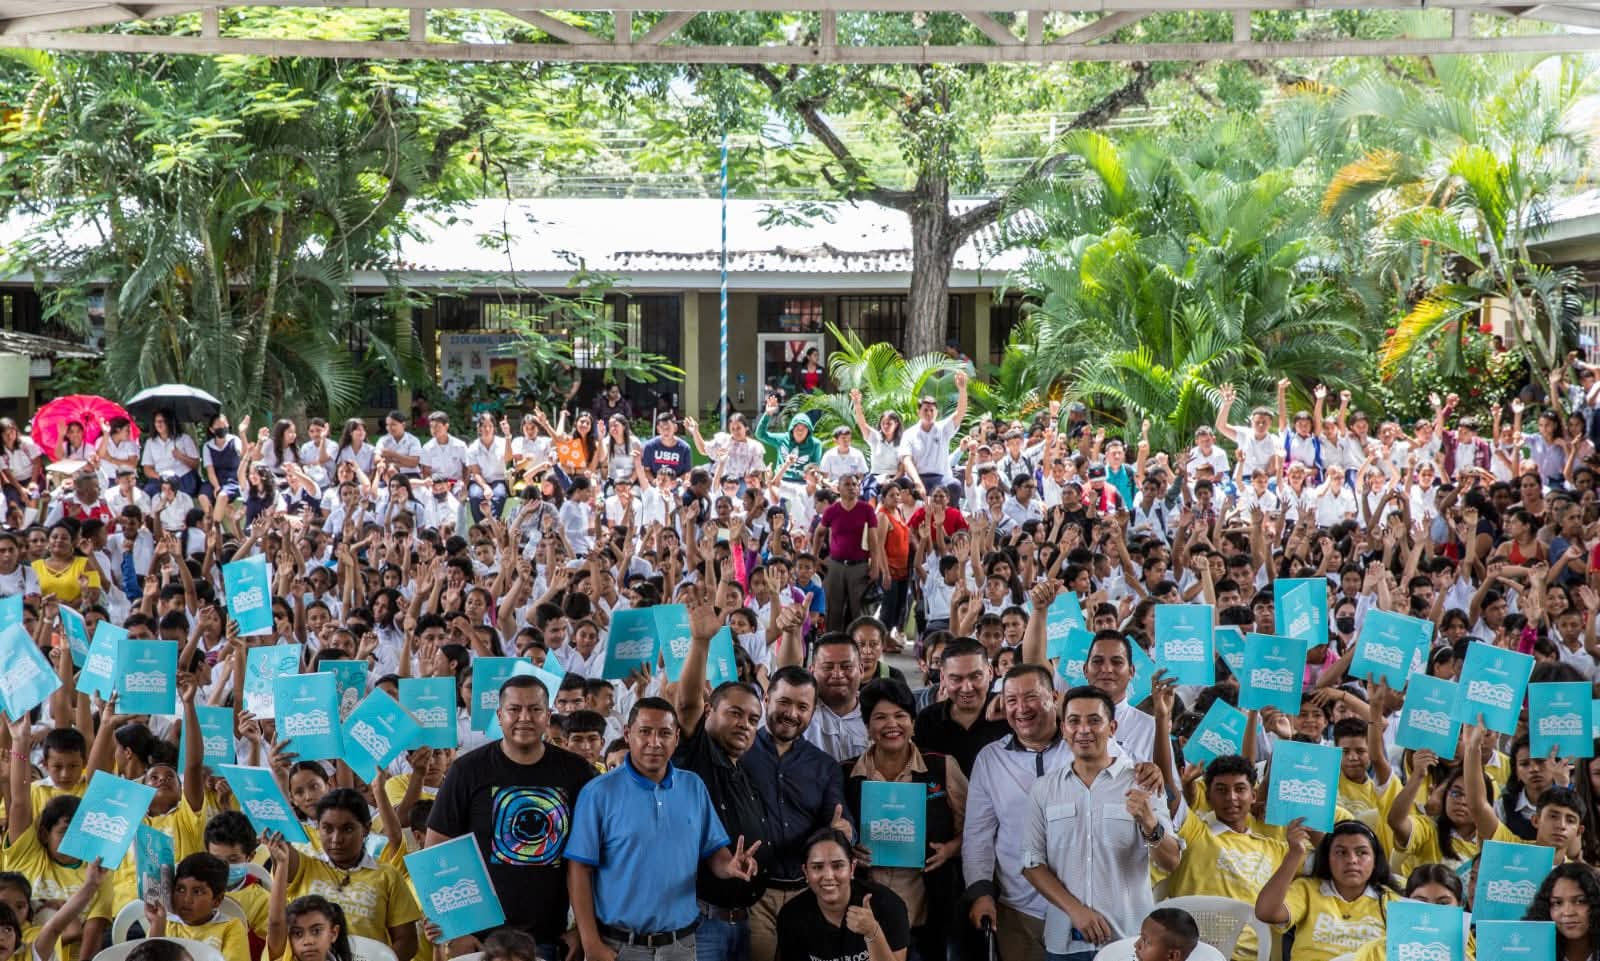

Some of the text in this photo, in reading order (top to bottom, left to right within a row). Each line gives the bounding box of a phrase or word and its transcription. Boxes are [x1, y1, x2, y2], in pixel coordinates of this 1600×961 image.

[654, 450, 680, 462] USA
[1280, 779, 1326, 798] Becas
[871, 819, 914, 833] Becas
[429, 885, 480, 907] Becas
